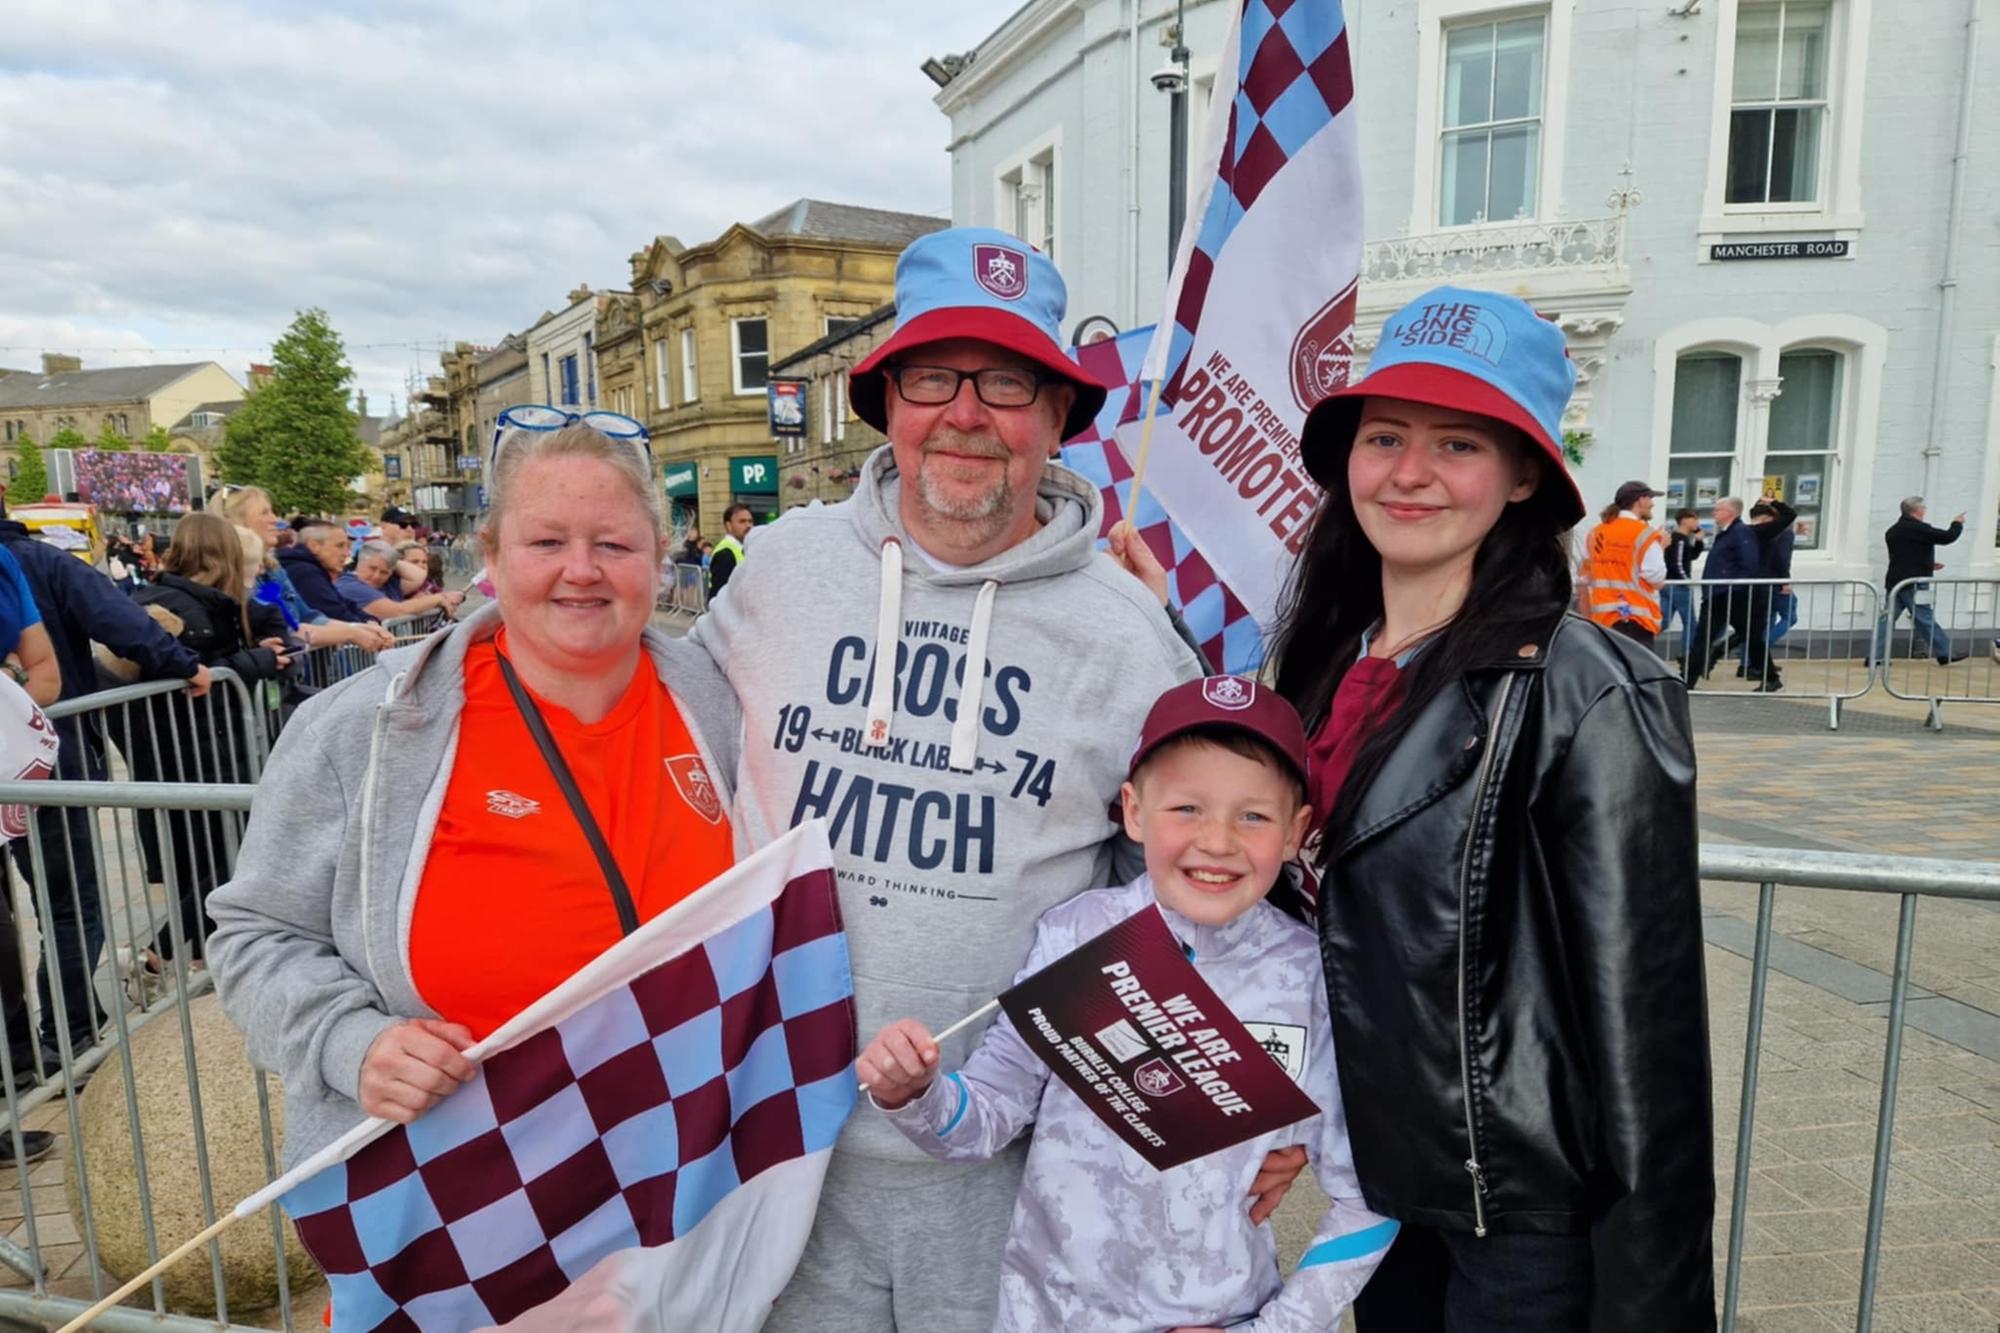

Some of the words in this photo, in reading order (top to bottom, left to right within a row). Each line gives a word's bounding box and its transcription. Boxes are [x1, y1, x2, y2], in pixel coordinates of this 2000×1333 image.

[1714, 244, 1799, 258] MANCHESTER
[1806, 242, 1844, 255] ROAD
[1394, 316, 1474, 339] LONG
[1401, 330, 1470, 349] SIDE
[1422, 302, 1481, 318] THE
[1206, 350, 1232, 380] WE
[1223, 373, 1256, 407] ARE
[1247, 399, 1301, 465] PREMIER
[904, 620, 970, 645] VINTAGE
[773, 703, 812, 753] 19
[910, 740, 974, 776] LAB
[1009, 749, 1057, 808] 74
[790, 759, 996, 875] HATCH
[837, 869, 877, 886] WARD
[884, 879, 956, 900] THINKING
[1101, 960, 1188, 1051] PREMIER
[1171, 1049, 1253, 1117] LEAGUE
[1161, 992, 1207, 1027] WE
[1187, 1028, 1243, 1067] ARE
[1027, 1006, 1063, 1044] PROUD
[1055, 1042, 1101, 1084] PARTNER
[1093, 1082, 1113, 1095] OF
[1106, 1095, 1131, 1114] THE
[1122, 1112, 1167, 1148] CLARETS
[1068, 1035, 1116, 1076] BURNLEY
[1107, 1075, 1151, 1114] COLLEGE
